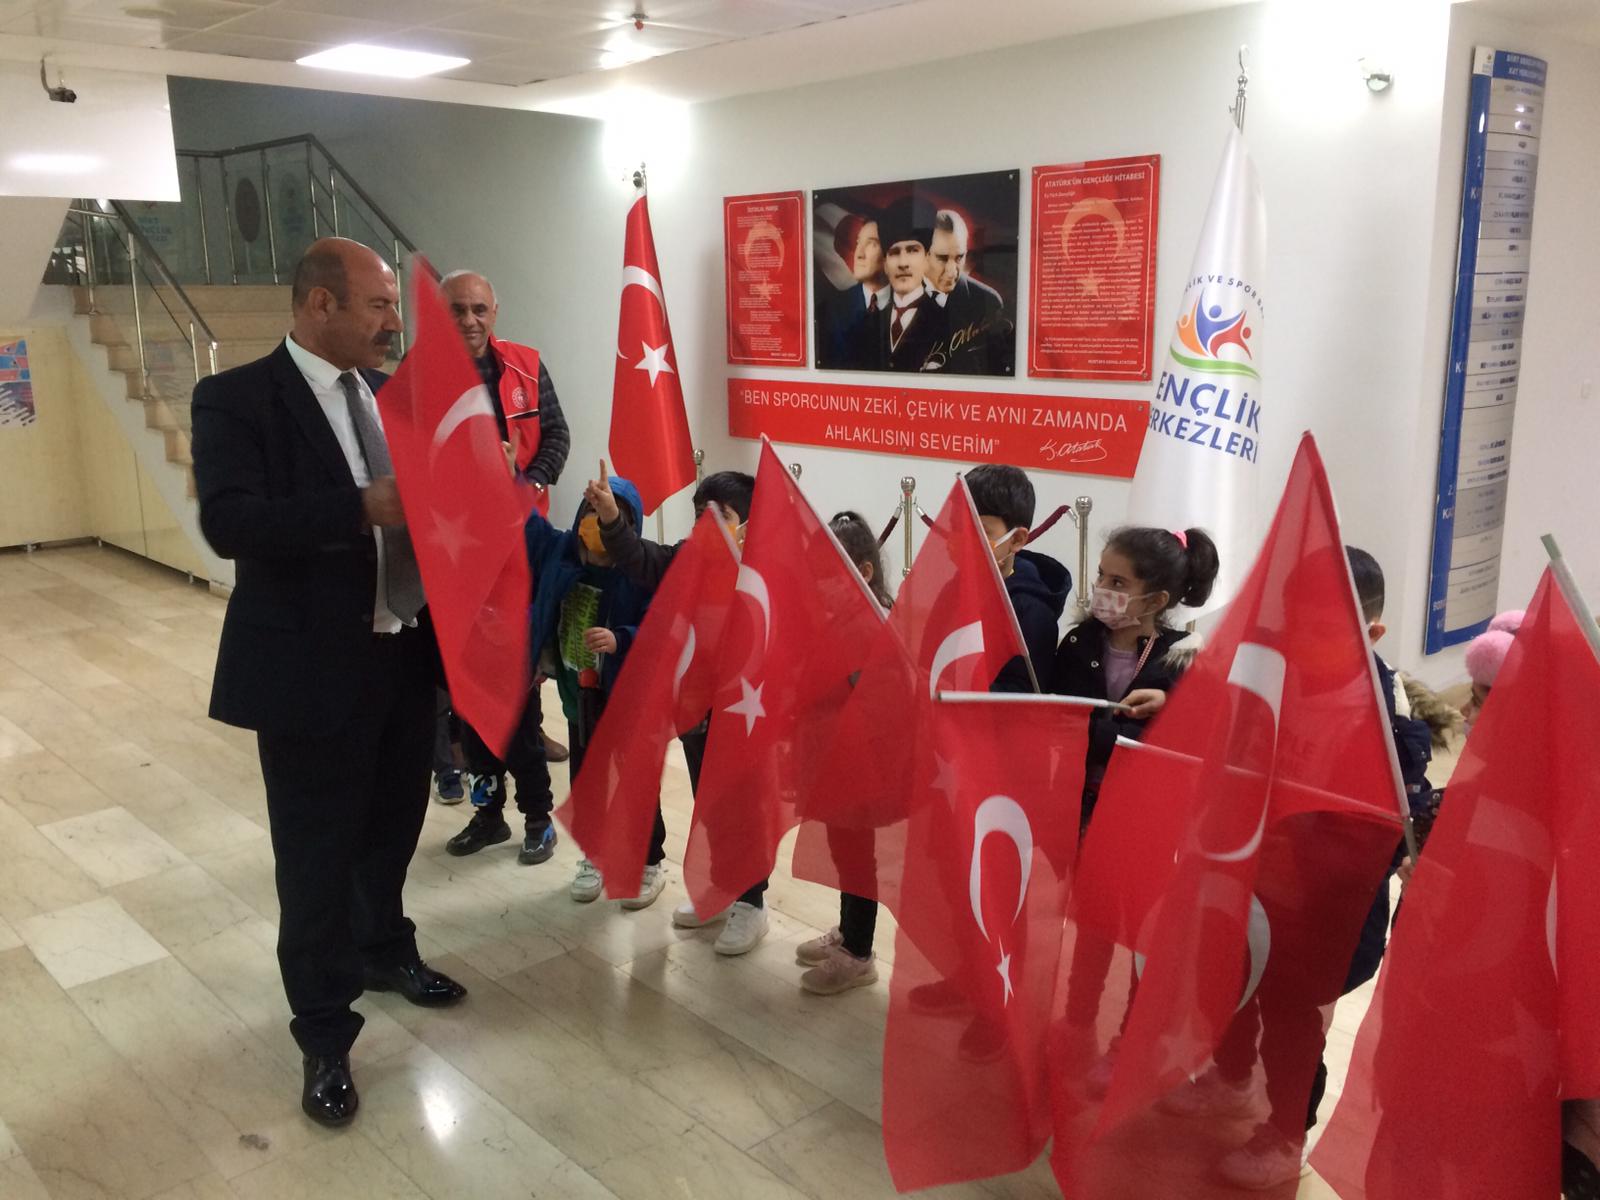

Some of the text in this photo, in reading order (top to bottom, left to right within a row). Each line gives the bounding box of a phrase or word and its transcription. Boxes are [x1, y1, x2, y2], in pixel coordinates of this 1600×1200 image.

[1208, 275, 1223, 284] VE
[773, 391, 860, 413] SPORCUNUN
[864, 395, 902, 418] ZEKİ,
[906, 399, 954, 421] ÇEVİK
[959, 403, 981, 422] VE
[986, 406, 1026, 425] AYNI
[1031, 408, 1127, 433] ZAMANDA
[824, 424, 915, 448] AHLAKLISINI
